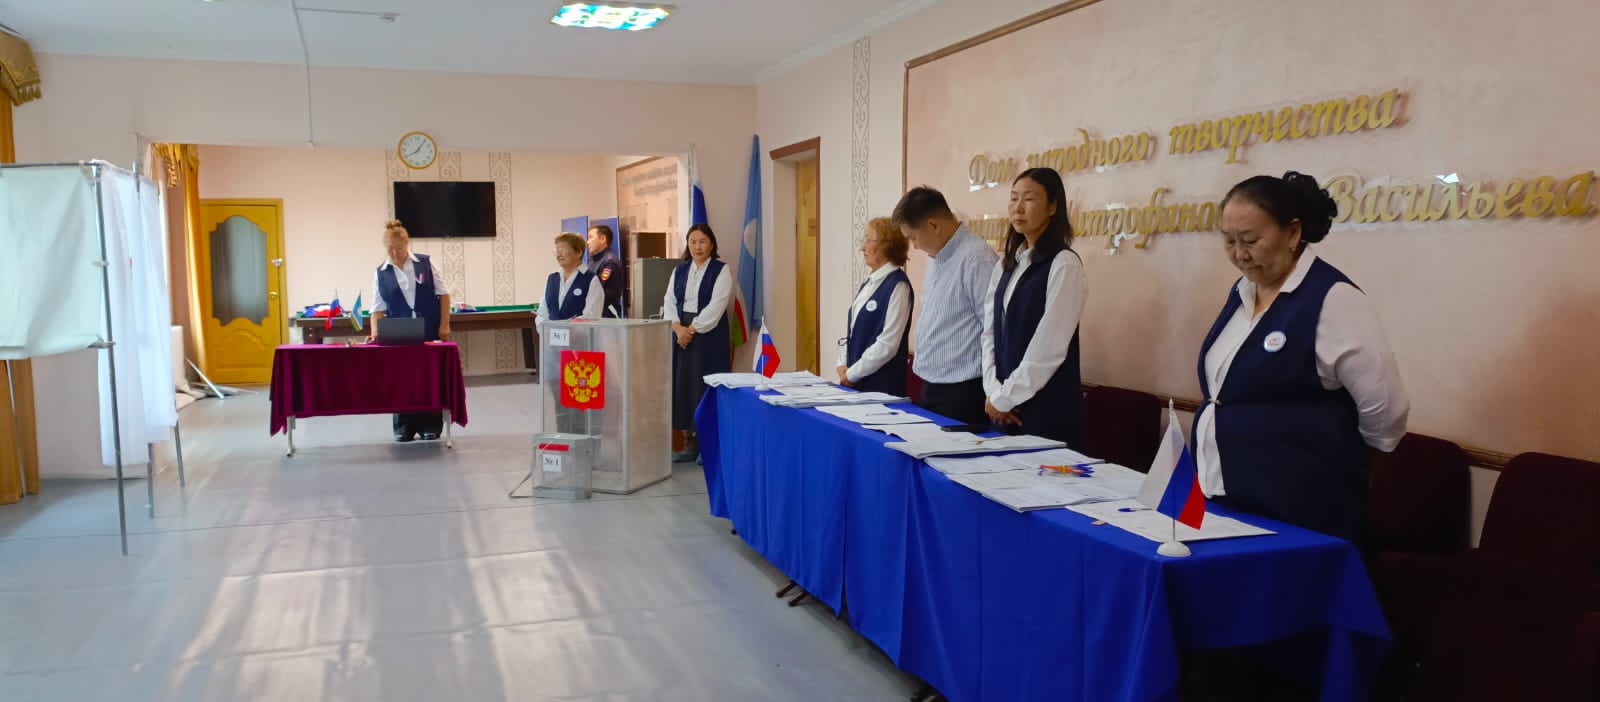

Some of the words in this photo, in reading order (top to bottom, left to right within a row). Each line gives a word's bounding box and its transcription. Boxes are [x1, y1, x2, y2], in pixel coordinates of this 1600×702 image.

[968, 154, 1012, 185] Дом
[1168, 87, 1399, 164] творчества
[1322, 169, 1595, 224] Васильева
